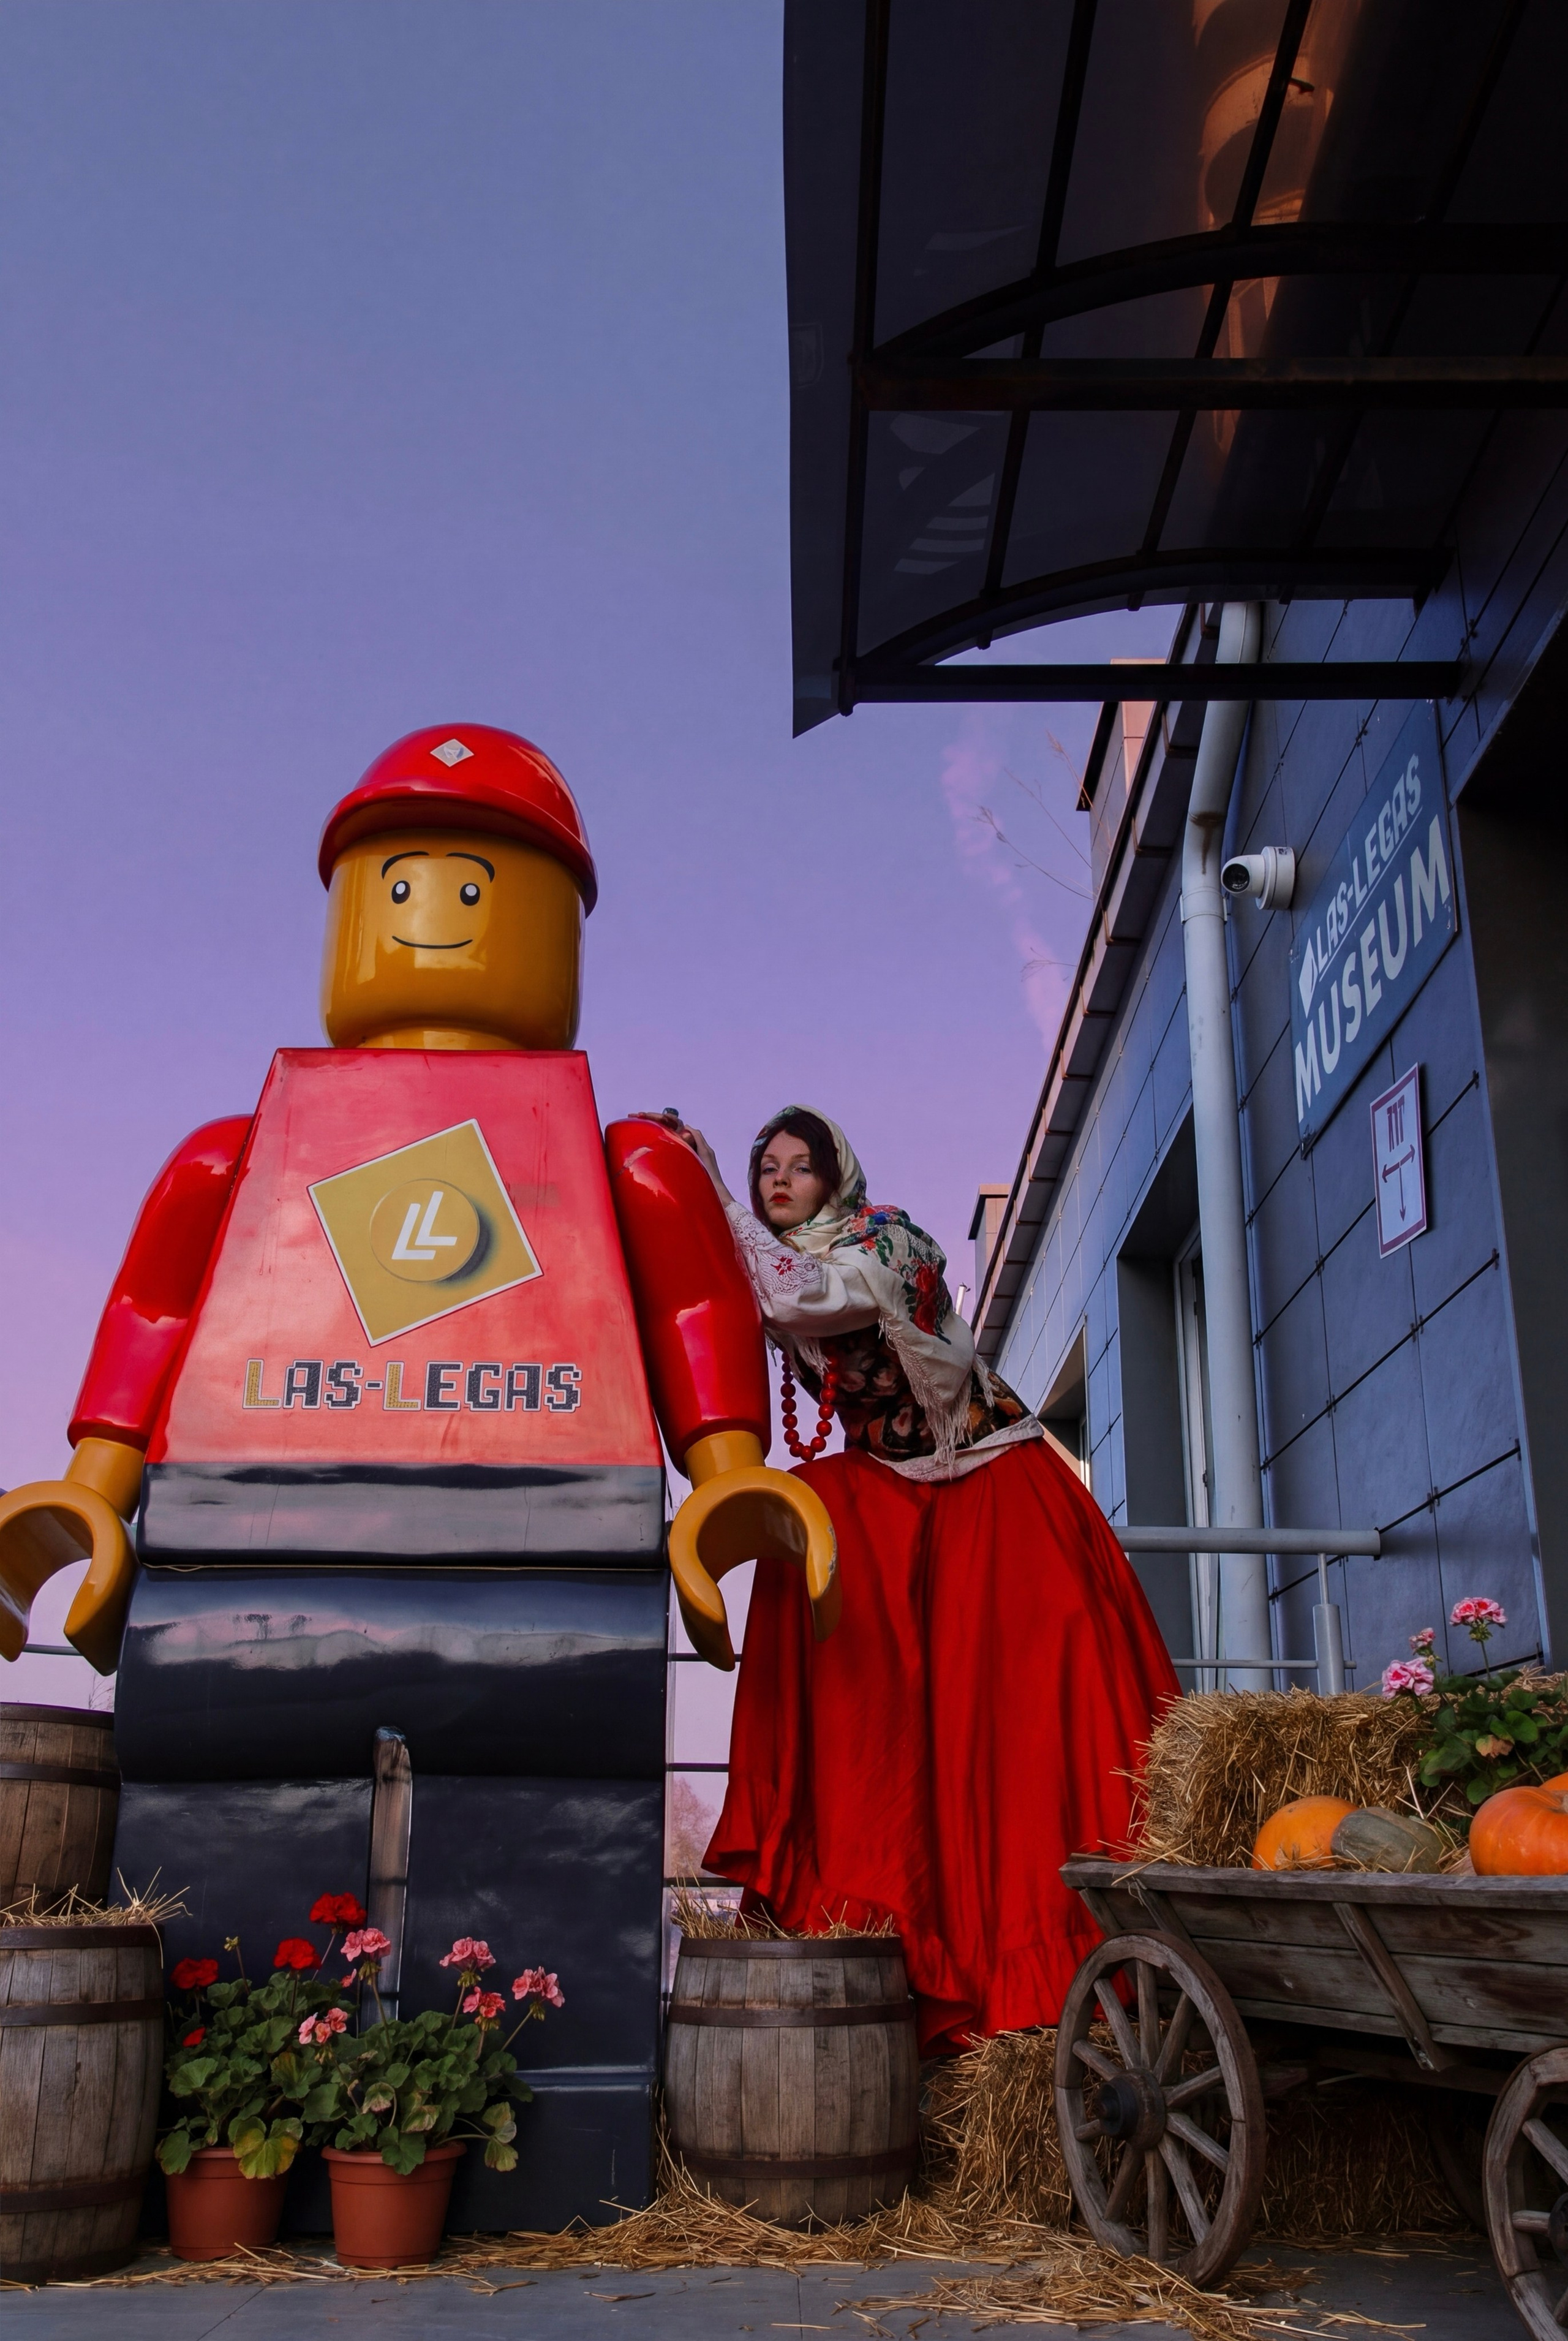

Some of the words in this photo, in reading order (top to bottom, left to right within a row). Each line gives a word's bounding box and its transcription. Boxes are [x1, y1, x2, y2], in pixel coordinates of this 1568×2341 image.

[1316, 754, 1422, 974] LAS-LEGAS
[1295, 814, 1450, 1123] MUSEUM
[391, 1190, 458, 1260] LL
[243, 1358, 581, 1412] LAS-LEGAS
